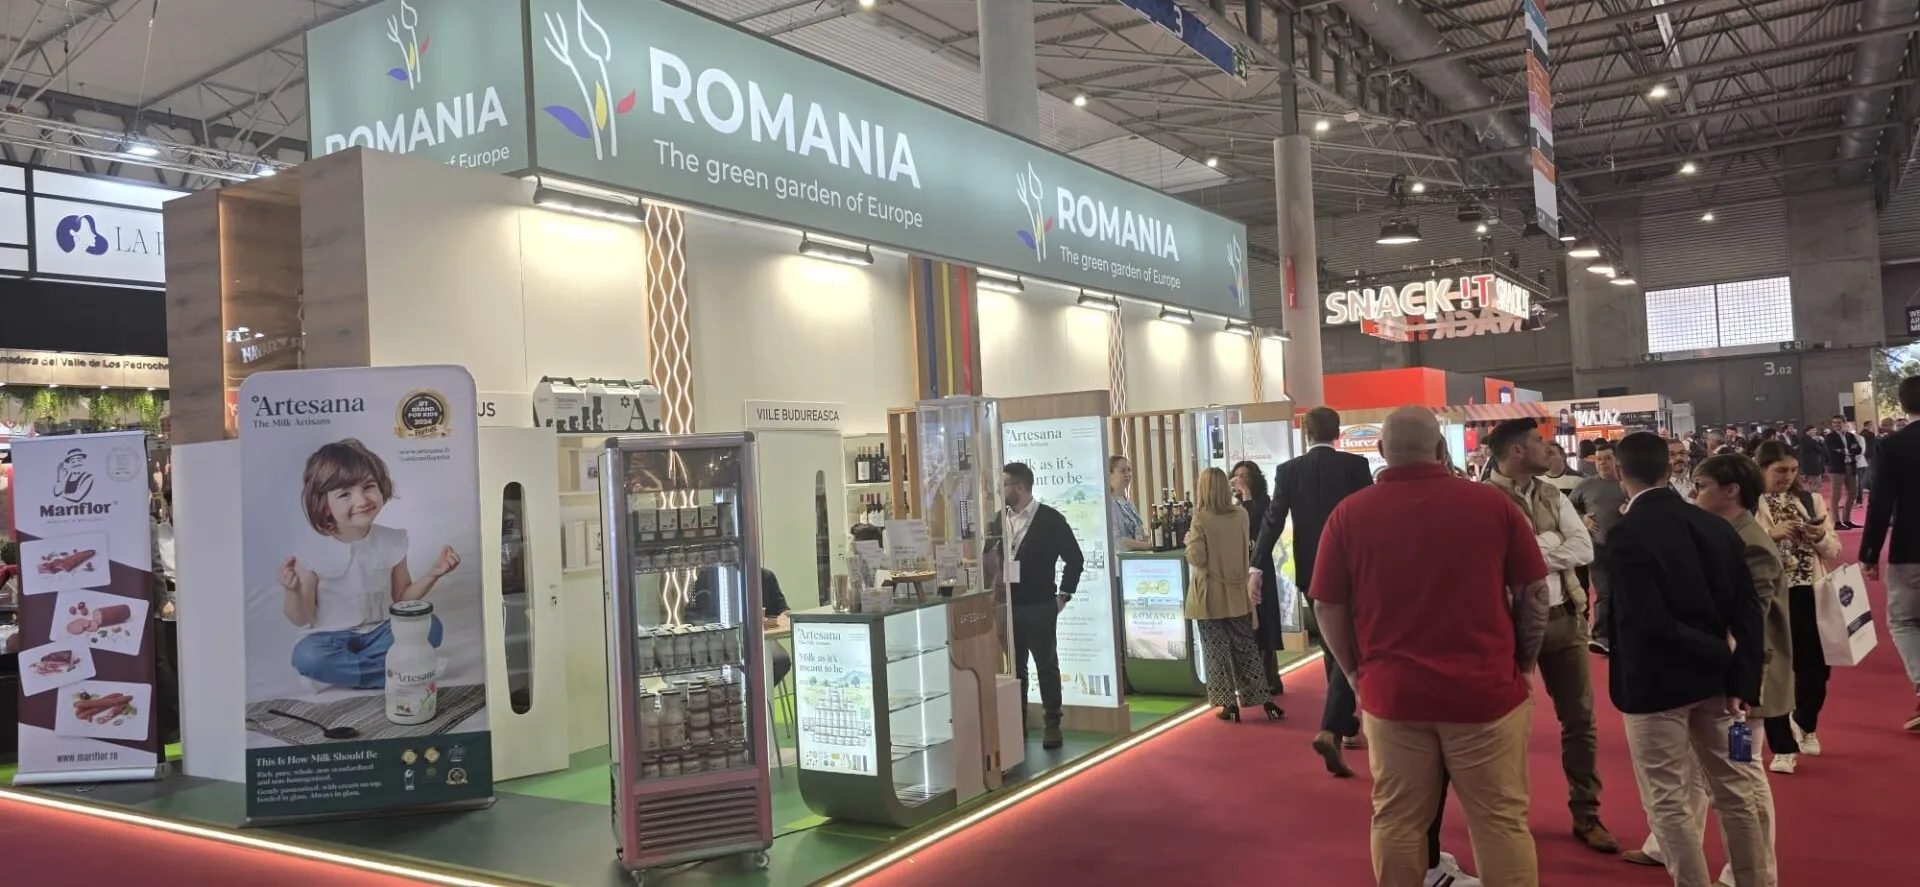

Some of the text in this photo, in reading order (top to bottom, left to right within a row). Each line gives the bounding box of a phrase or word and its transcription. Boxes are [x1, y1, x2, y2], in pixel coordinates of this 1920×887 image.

[1173, 4, 1184, 39] 3
[649, 46, 921, 190] ROMANIA
[459, 146, 510, 169] Europe
[653, 139, 923, 230] The green garden of Europe
[1057, 187, 1180, 262] ROMANIA
[115, 226, 148, 254] LA
[1060, 245, 1181, 290] The green garden of Europe
[1325, 278, 1456, 325] SNACK
[42, 357, 58, 367] del
[62, 358, 87, 368] Valle
[89, 359, 101, 368] de
[103, 360, 120, 369] Los
[1764, 361, 1793, 377] 3.02
[255, 395, 366, 417] Artesana
[756, 408, 840, 421] VIILE BUDUREASCA
[253, 417, 331, 429] The Milk Artisans
[1010, 429, 1062, 442] Artesana
[1040, 461, 1053, 470] as
[1056, 456, 1074, 470] it's
[1052, 475, 1064, 485] to
[1067, 471, 1083, 485] be
[39, 502, 112, 518] Mariflor
[799, 628, 841, 641] Artesana
[799, 653, 815, 662] Milk
[833, 664, 843, 673] be
[57, 751, 118, 763] www.mariflor.ro
[256, 750, 379, 767] This Is How Milk Should Be
